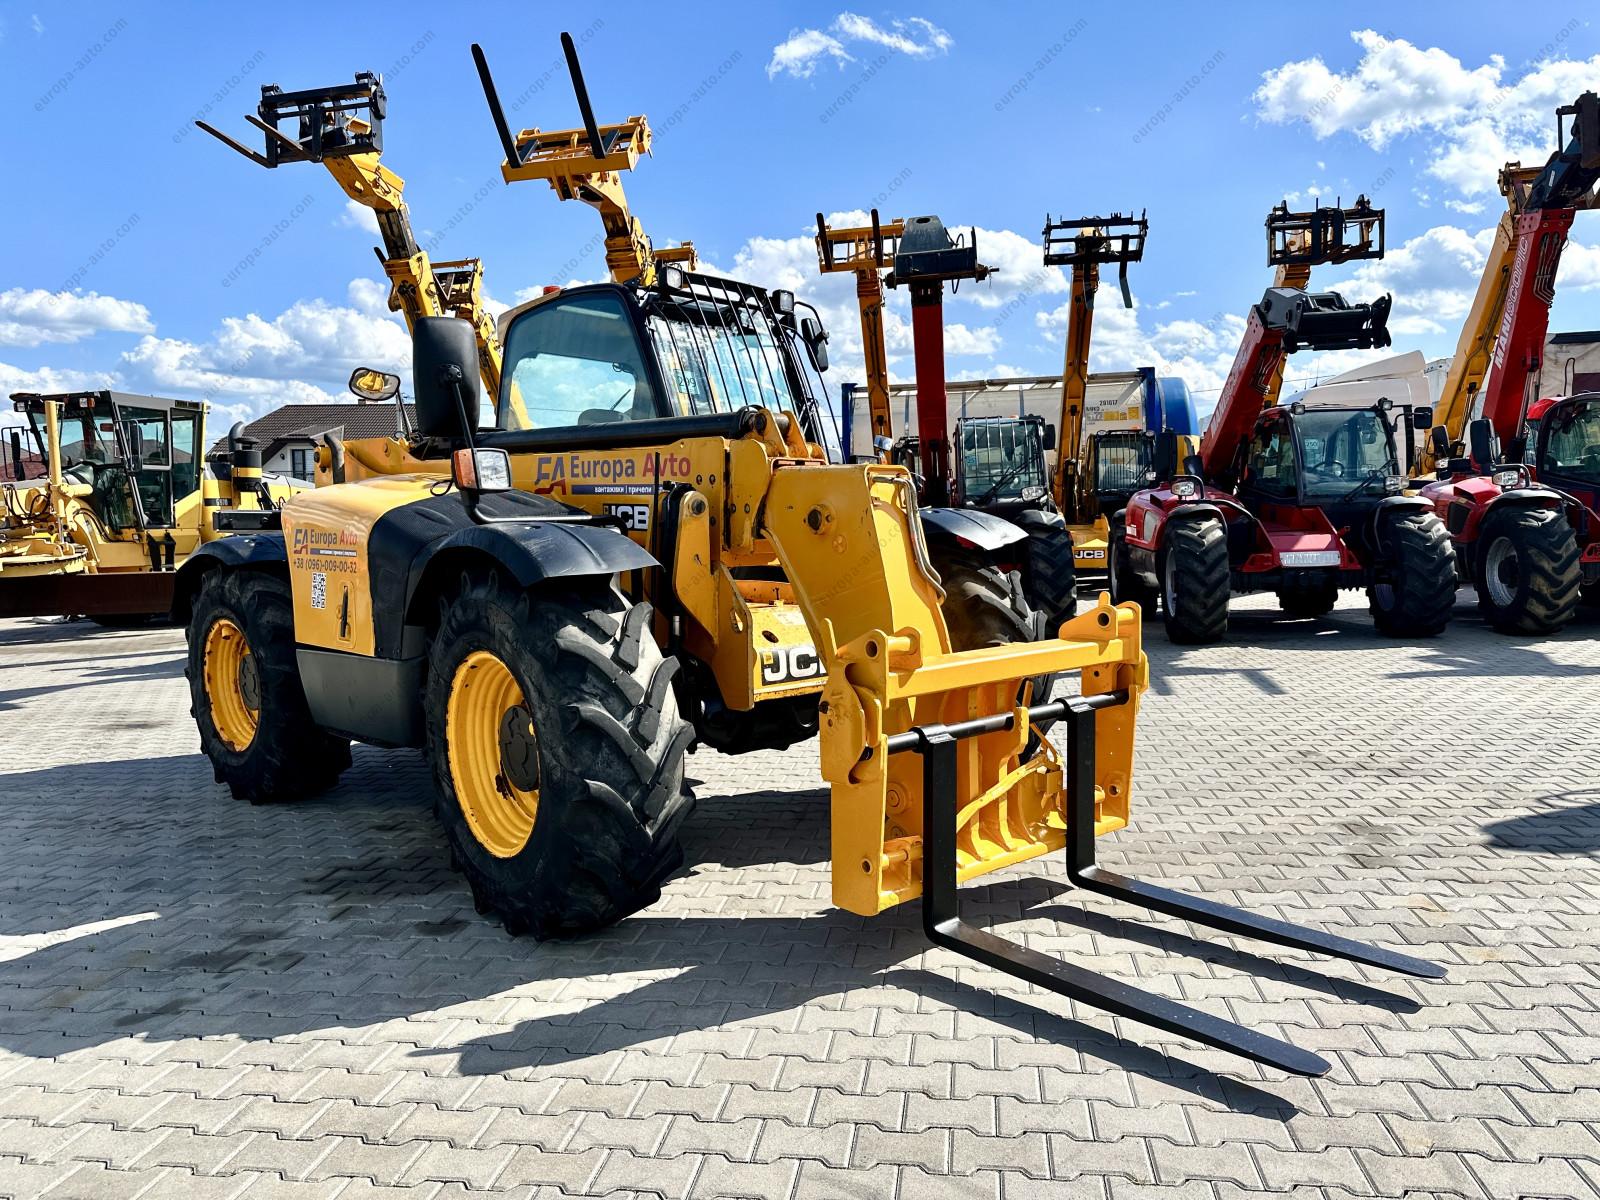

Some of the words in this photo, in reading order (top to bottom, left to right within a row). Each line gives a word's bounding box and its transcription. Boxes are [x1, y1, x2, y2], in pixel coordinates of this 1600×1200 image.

[571, 455, 636, 483] Europa
[642, 452, 691, 478] Avto
[310, 529, 338, 547] Europa
[339, 530, 358, 546] Avto
[1074, 550, 1105, 559] JCB
[763, 647, 827, 682] JC
